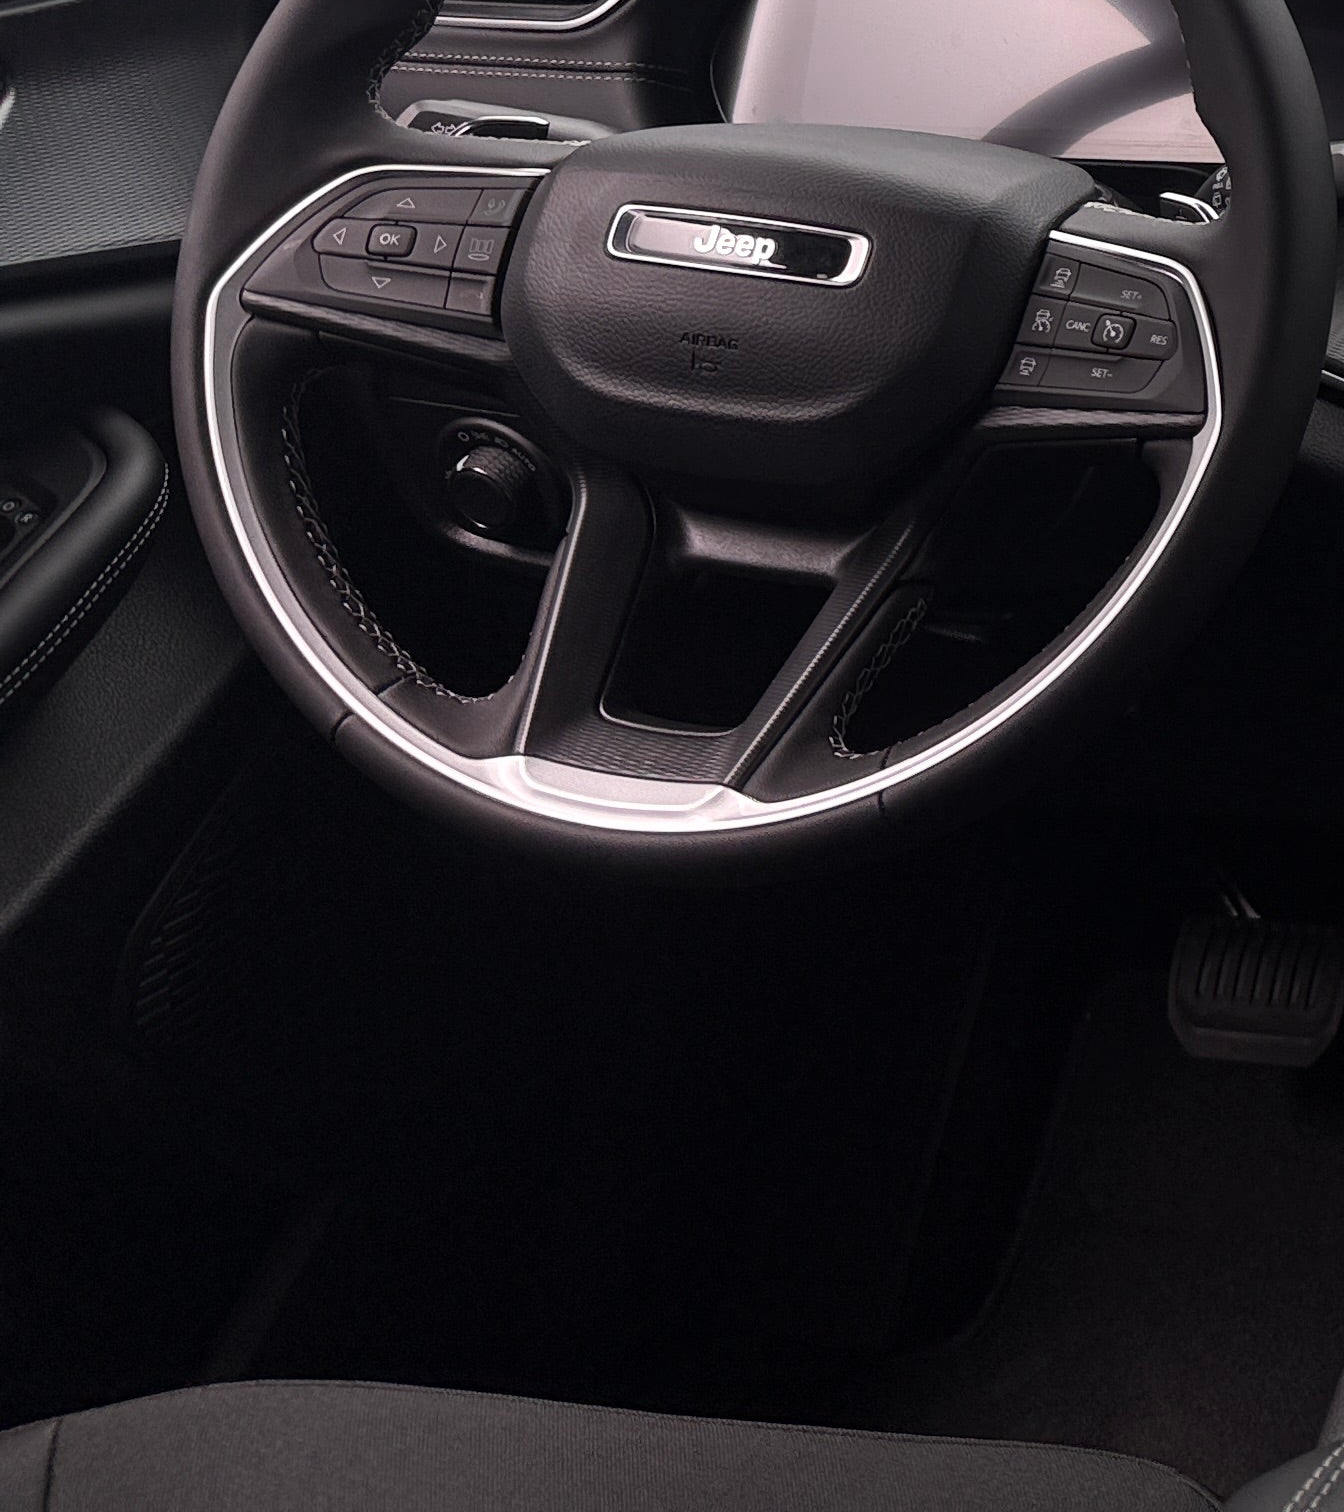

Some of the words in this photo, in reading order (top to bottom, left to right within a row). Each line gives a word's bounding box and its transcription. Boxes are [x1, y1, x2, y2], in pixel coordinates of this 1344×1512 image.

[378, 231, 401, 247] OK
[693, 224, 777, 265] Jeep
[1065, 319, 1091, 333] CANC
[679, 332, 739, 350] AIRBAG
[1150, 334, 1169, 346] RES
